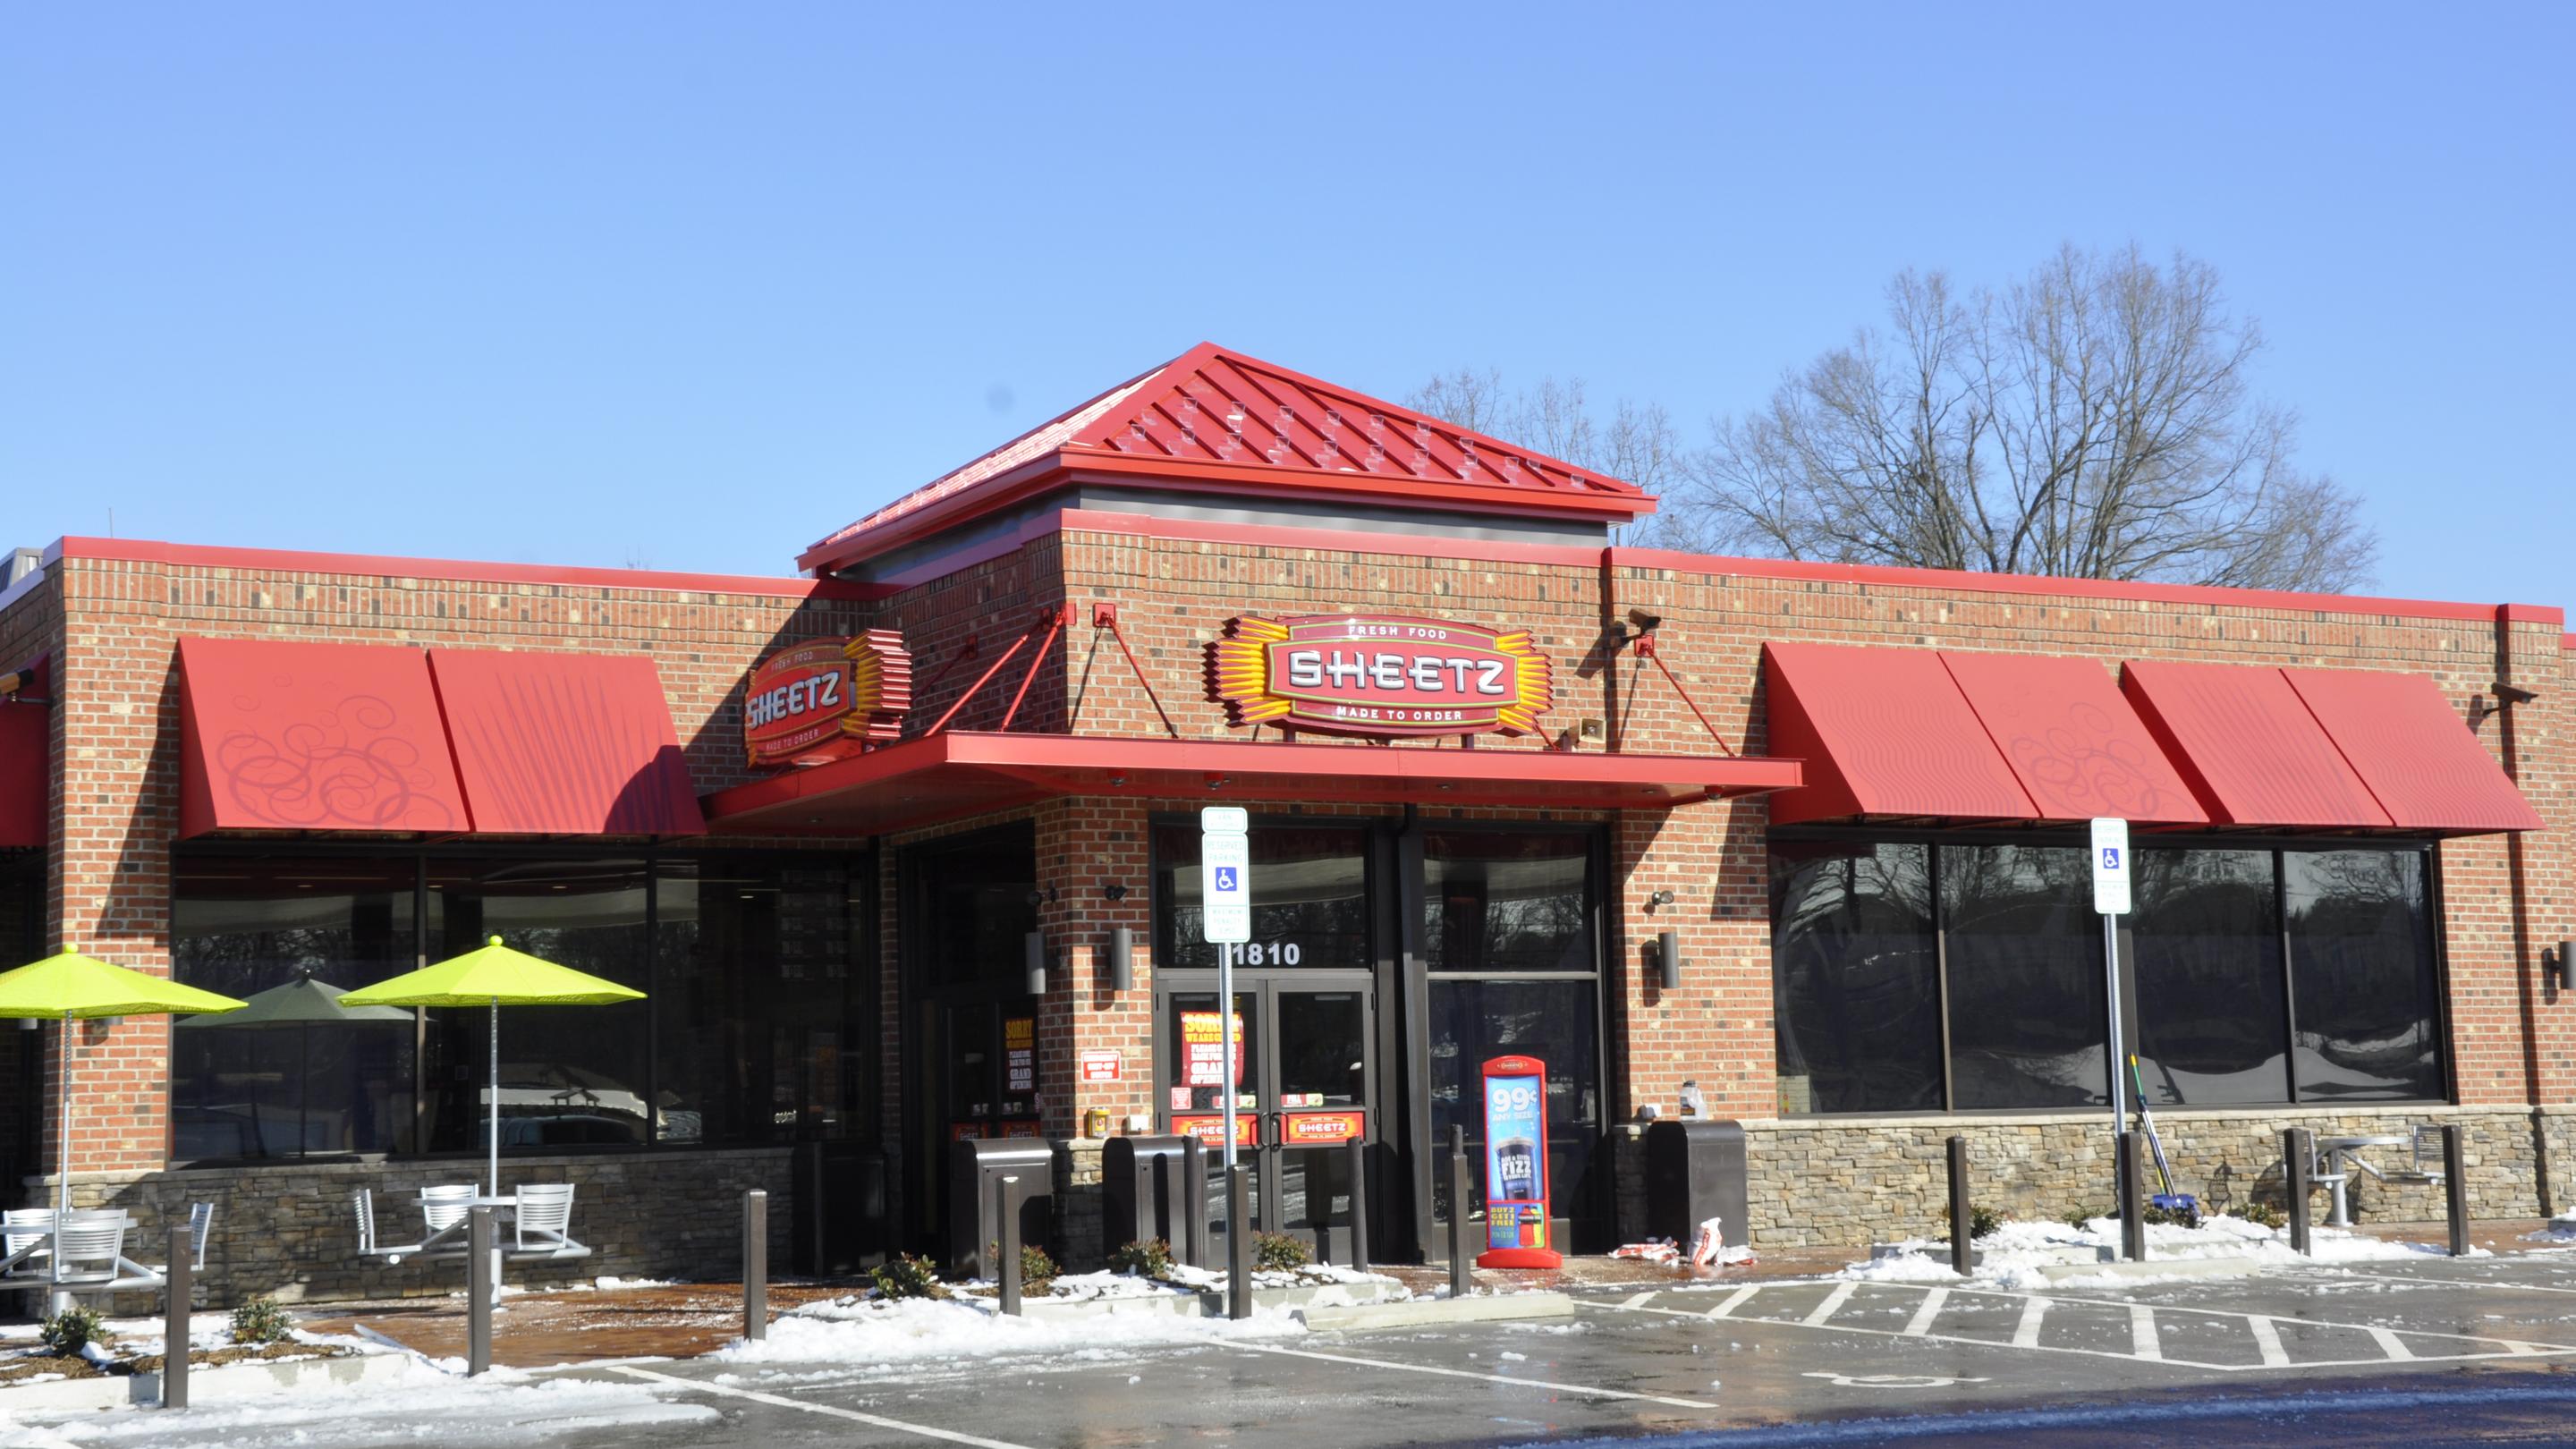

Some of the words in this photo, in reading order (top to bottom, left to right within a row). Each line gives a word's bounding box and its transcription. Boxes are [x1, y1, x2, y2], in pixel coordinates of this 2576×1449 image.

[1349, 626, 1398, 637] FRESH
[1409, 628, 1446, 640] FOOD
[1289, 650, 1505, 695] SHEETZ
[746, 671, 839, 730] SHEETZ
[1336, 706, 1378, 720] MADE
[1387, 708, 1406, 720] TO
[1413, 710, 1462, 721] ORDER
[794, 728, 819, 745] ORDER
[1232, 943, 1301, 965] 1810
[1010, 1068, 1031, 1080] GRAND
[1493, 1113, 1510, 1122] ANY
[1514, 1110, 1532, 1119] SIZE
[1299, 1123, 1346, 1132] SHEETZ
[1501, 1160, 1531, 1175] FIZZ
